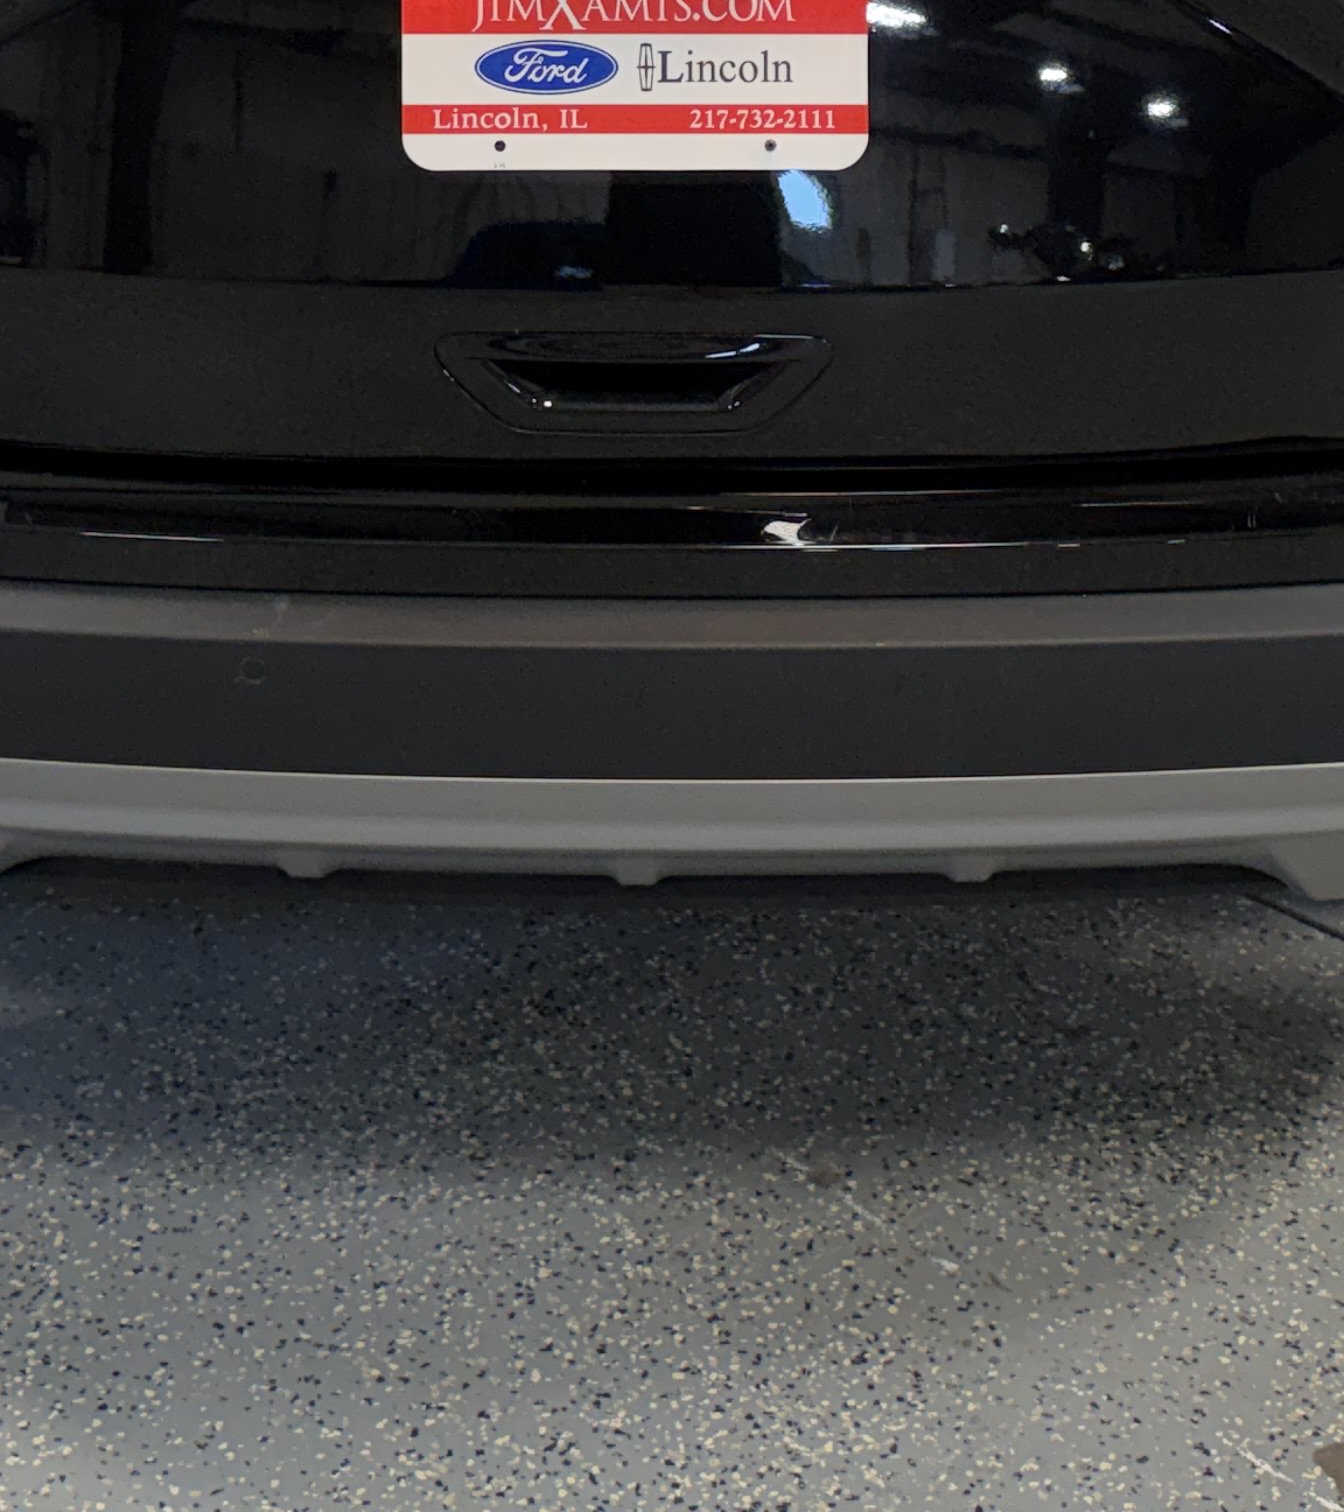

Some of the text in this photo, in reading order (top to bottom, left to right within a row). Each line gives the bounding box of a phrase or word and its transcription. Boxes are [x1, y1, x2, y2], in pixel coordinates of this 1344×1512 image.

[504, 46, 587, 84] Ford
[657, 49, 794, 85] Lincoln
[432, 107, 588, 133] Lincoln, IL
[689, 108, 836, 130] 217-732-2111
